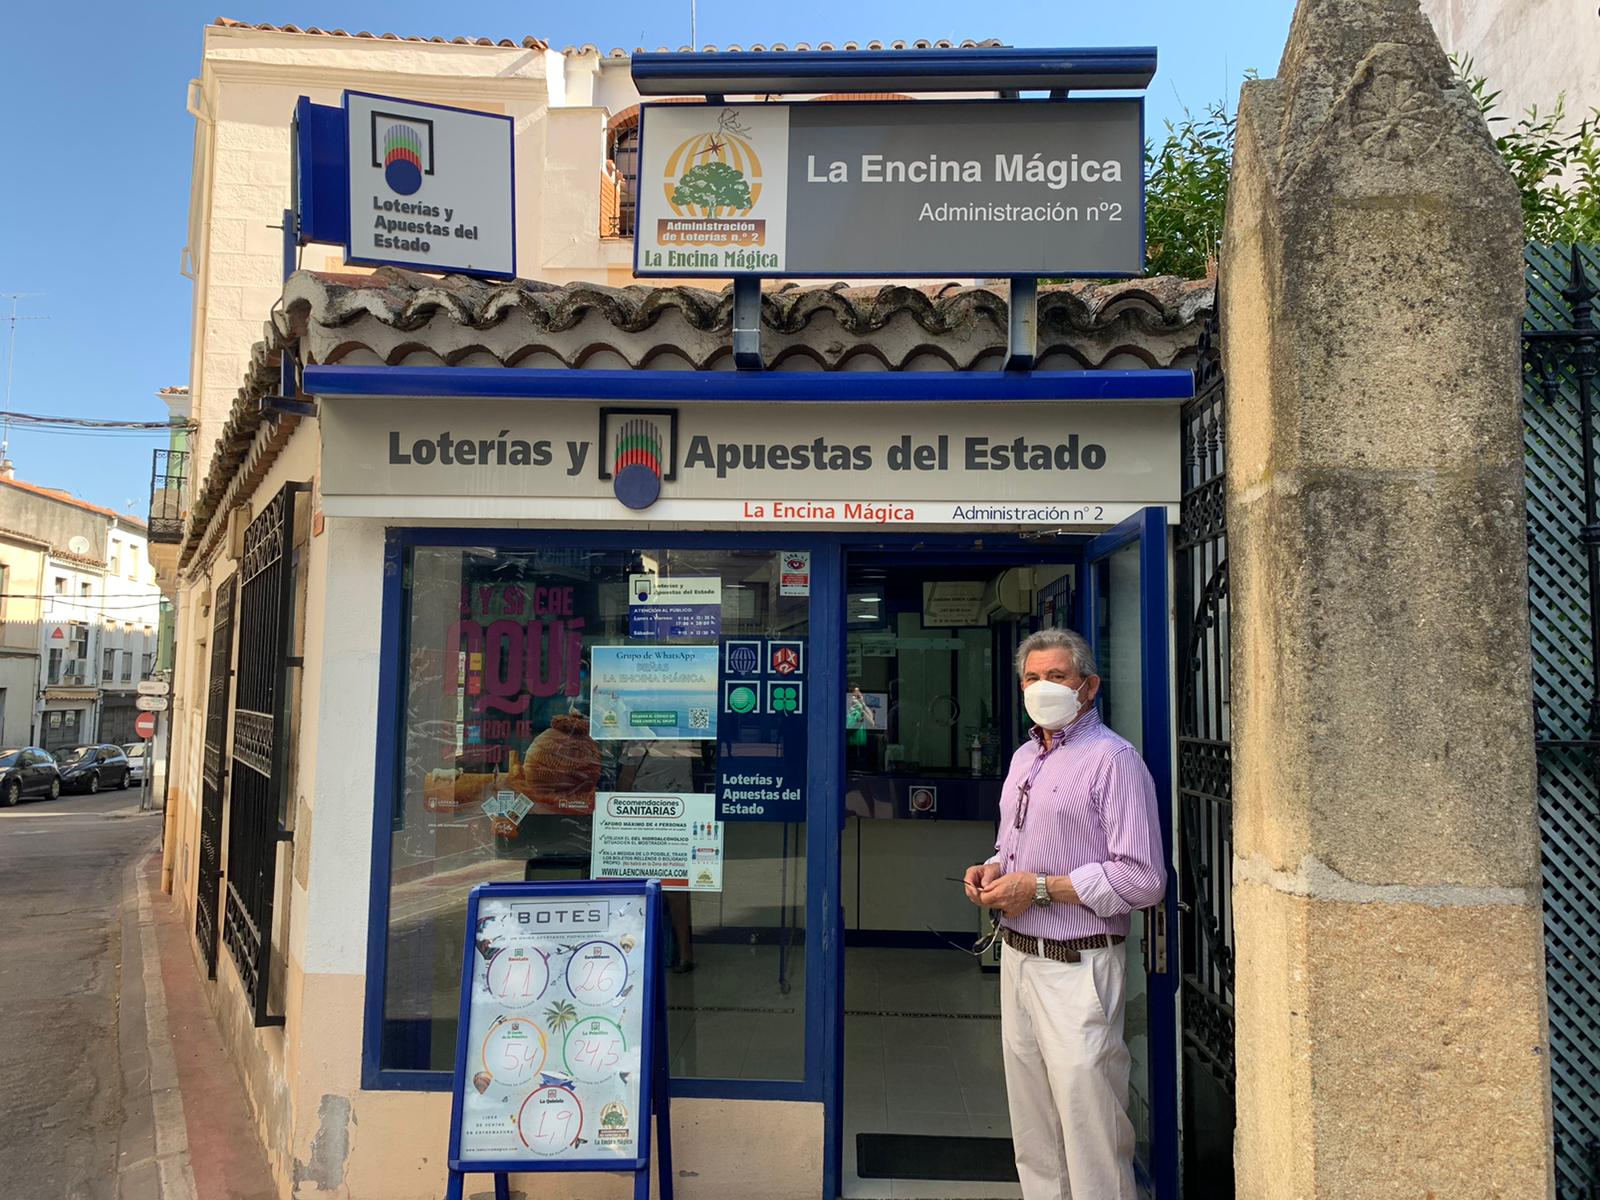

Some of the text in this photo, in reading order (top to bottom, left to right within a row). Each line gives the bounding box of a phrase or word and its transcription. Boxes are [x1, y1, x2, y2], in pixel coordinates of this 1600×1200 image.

[806, 152, 1123, 190] La Encina Mágica
[373, 195, 453, 222] Loterías y
[918, 201, 1079, 222] Administración
[374, 215, 478, 240] Apuestas del
[667, 222, 755, 231] Administración
[374, 233, 430, 252] Estado
[662, 233, 676, 241] de
[680, 232, 727, 242] Loterías
[751, 233, 759, 242] 2
[644, 249, 778, 270] La Encina Mágica
[389, 430, 1107, 478] Loterías y Apuestas del Estado
[743, 502, 764, 519] La
[773, 501, 836, 520] Encina
[843, 502, 915, 524] Mágica
[952, 505, 1070, 521] Administración
[1094, 507, 1104, 521] 2
[616, 651, 696, 661] Grupo de WhatsApp
[722, 773, 783, 788] Loterías y
[723, 788, 801, 801] Apuestas del
[613, 799, 679, 807] Recomendaciones
[722, 803, 764, 815] Estado
[616, 806, 676, 816] SANITARIAS
[601, 868, 688, 877] WWW.LAENCINAMAGICA.COM
[517, 909, 601, 924] BOTES
[575, 960, 616, 992] 26
